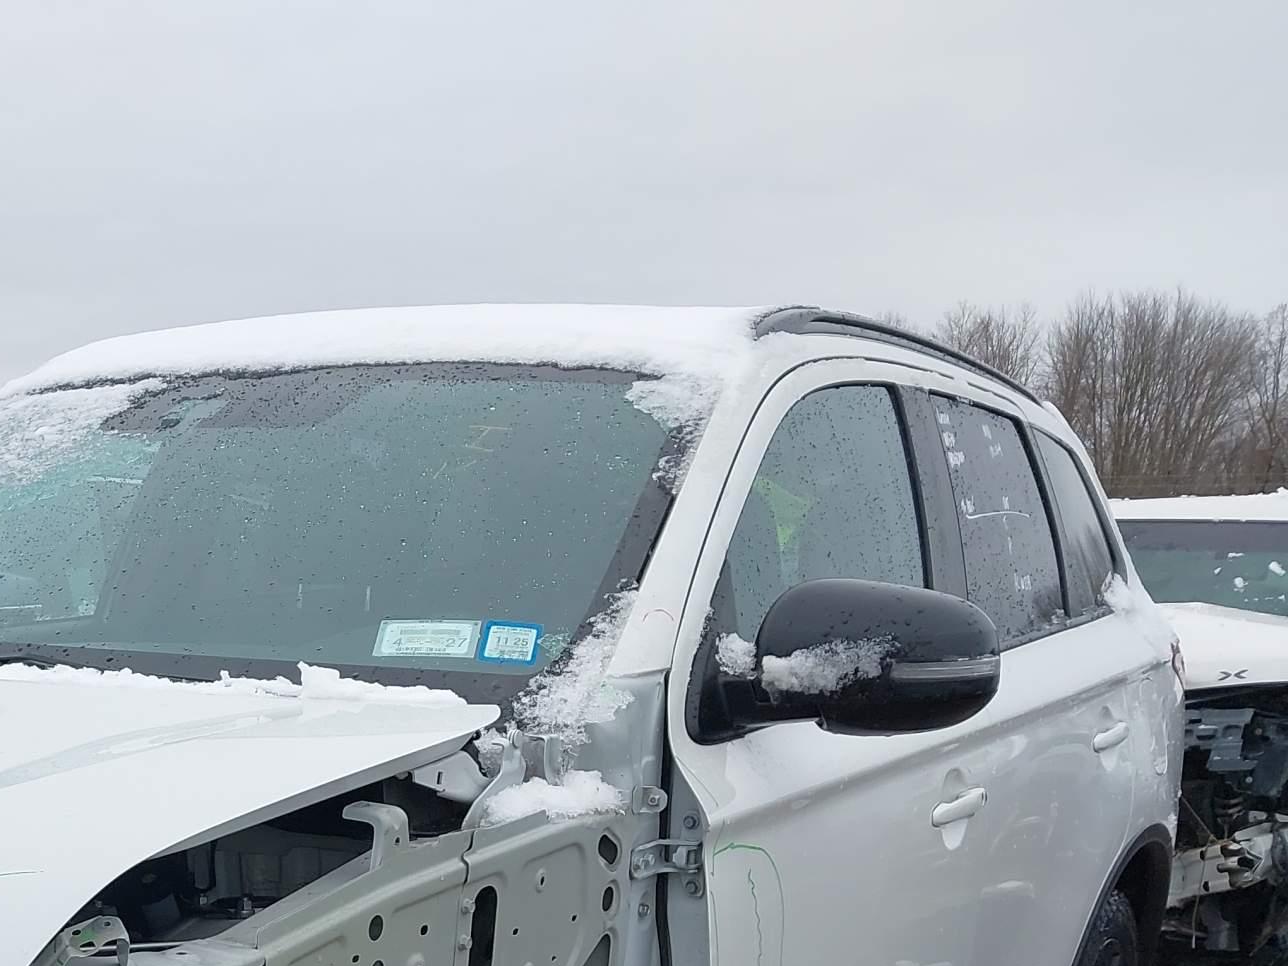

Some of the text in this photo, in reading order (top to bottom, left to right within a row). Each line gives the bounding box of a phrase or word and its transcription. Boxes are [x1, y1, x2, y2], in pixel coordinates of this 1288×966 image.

[392, 637, 468, 648] 4 27
[495, 636, 529, 647] 11 25
